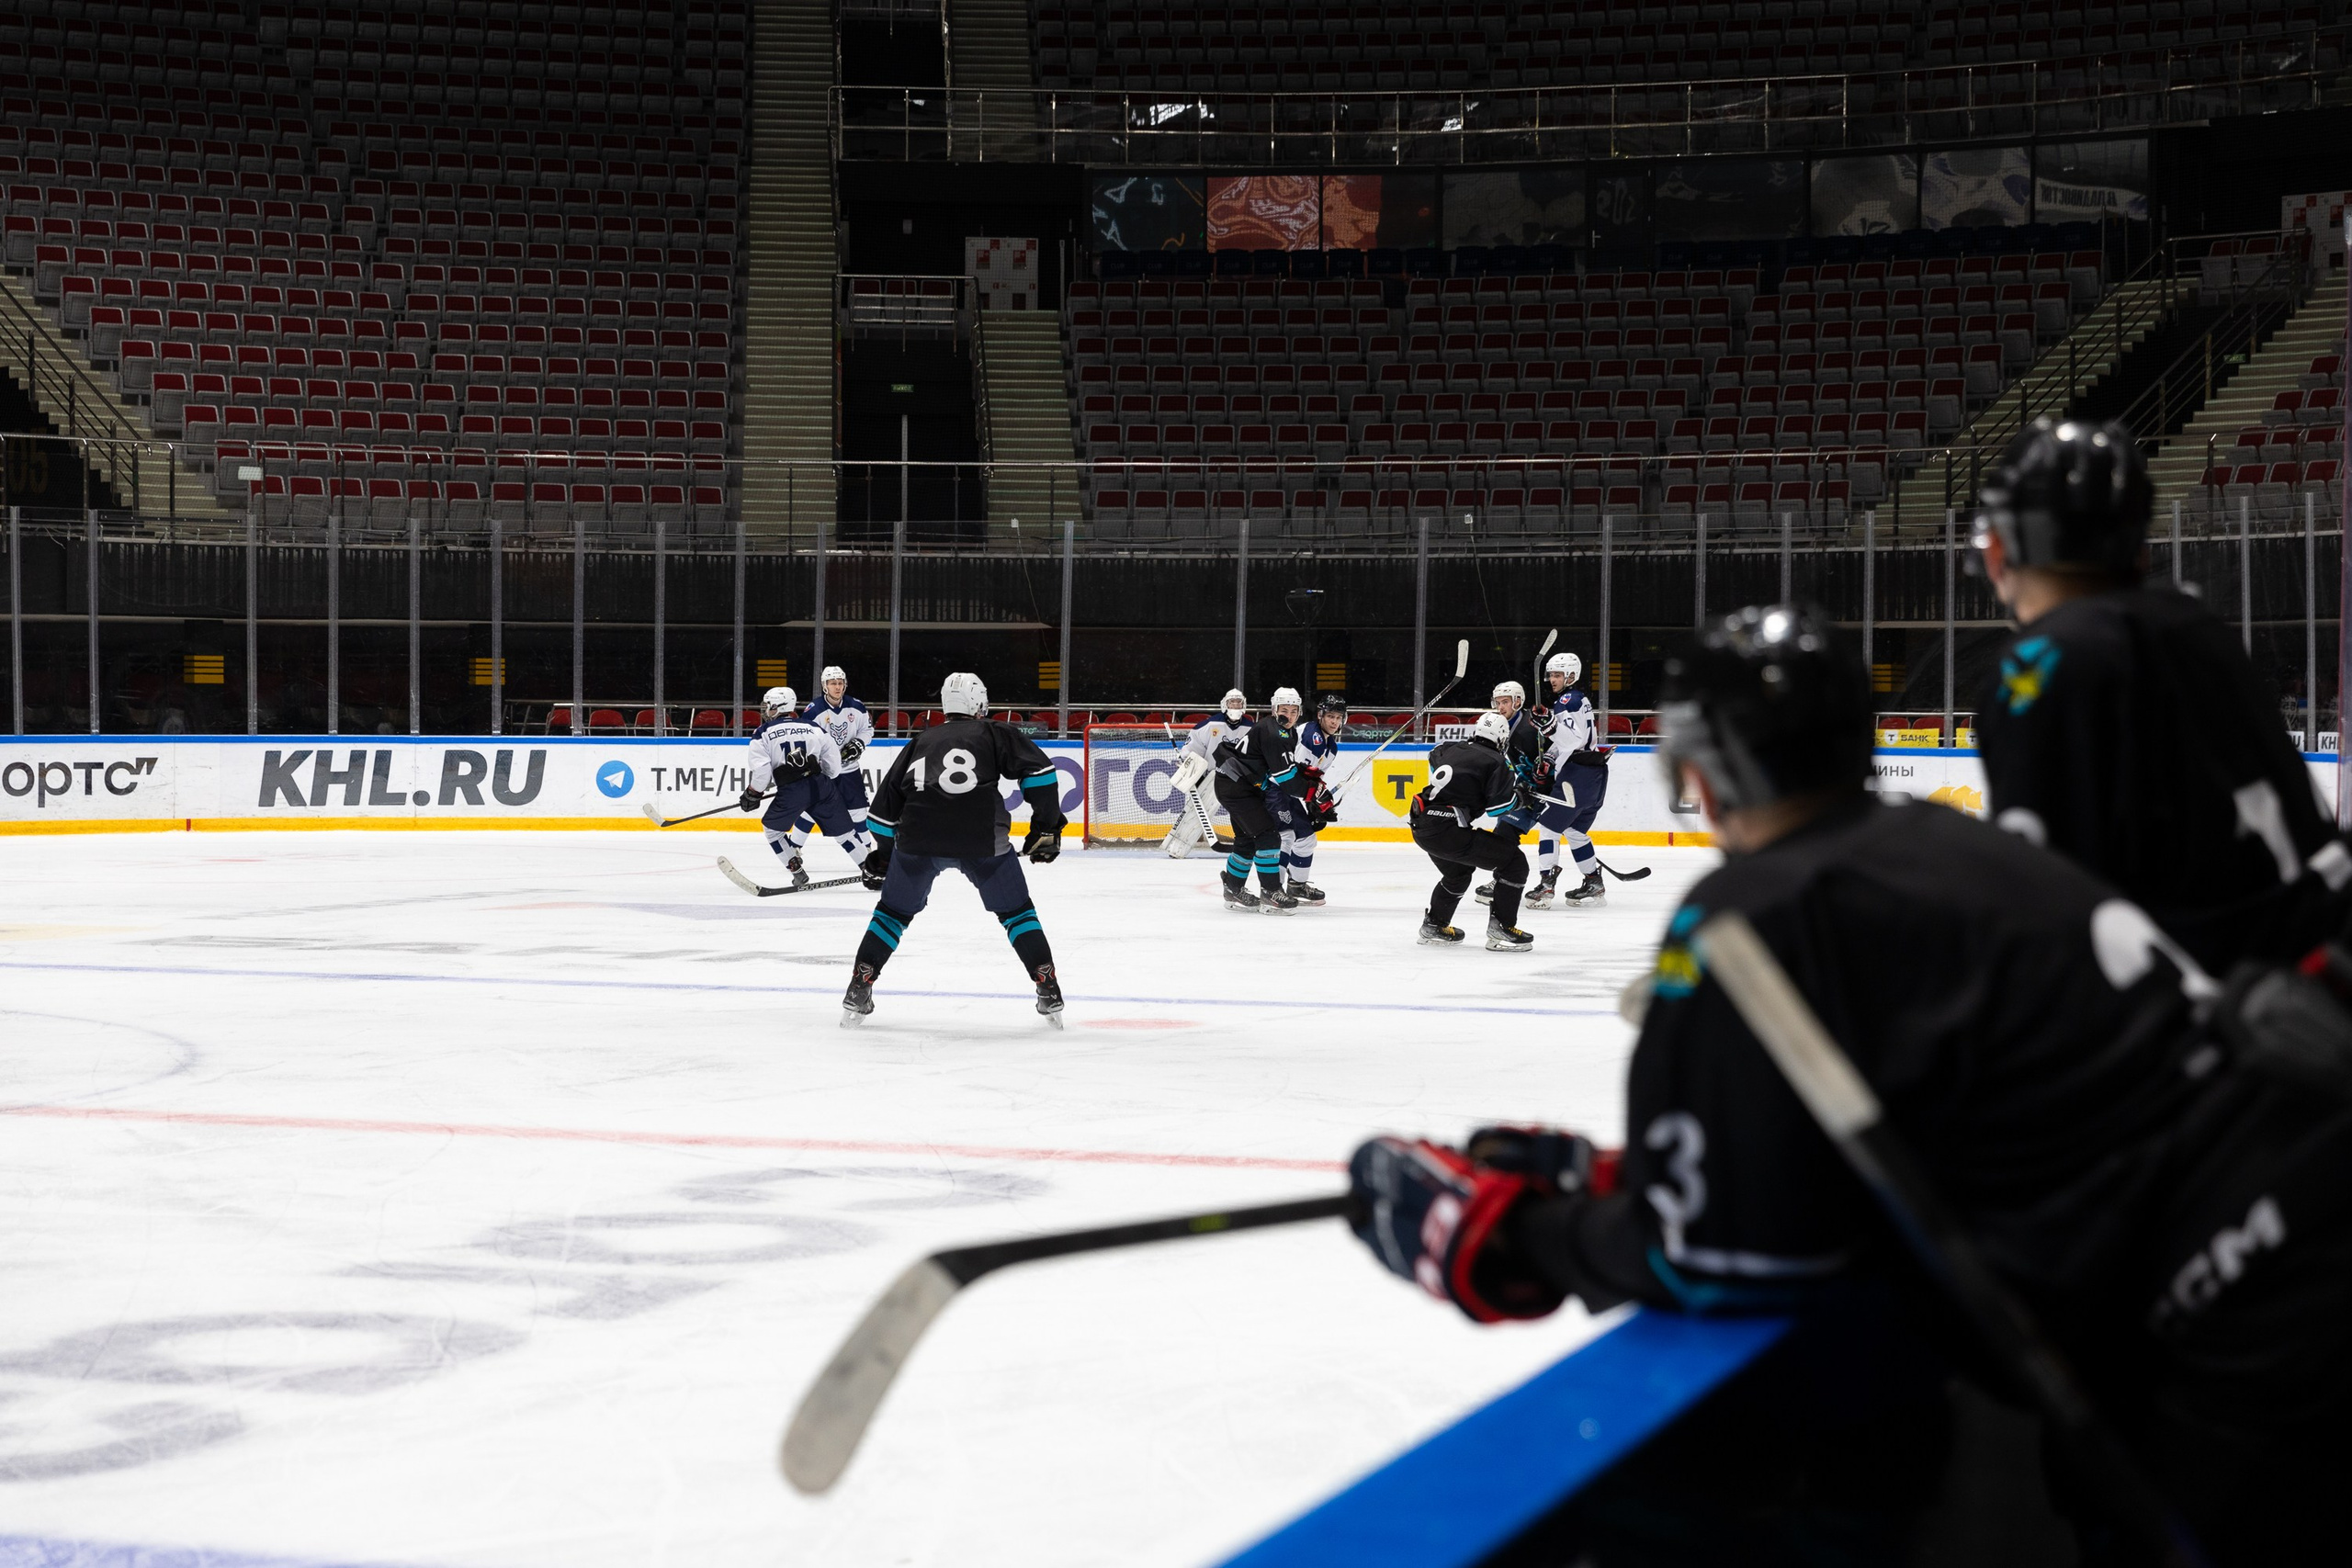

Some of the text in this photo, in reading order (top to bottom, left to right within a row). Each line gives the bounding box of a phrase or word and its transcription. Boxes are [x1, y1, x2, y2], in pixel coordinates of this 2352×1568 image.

[1439, 728, 1476, 740] KHL
[1900, 734, 1929, 742] БАНК
[258, 750, 548, 807] KHL.RU
[905, 748, 978, 795] 18
